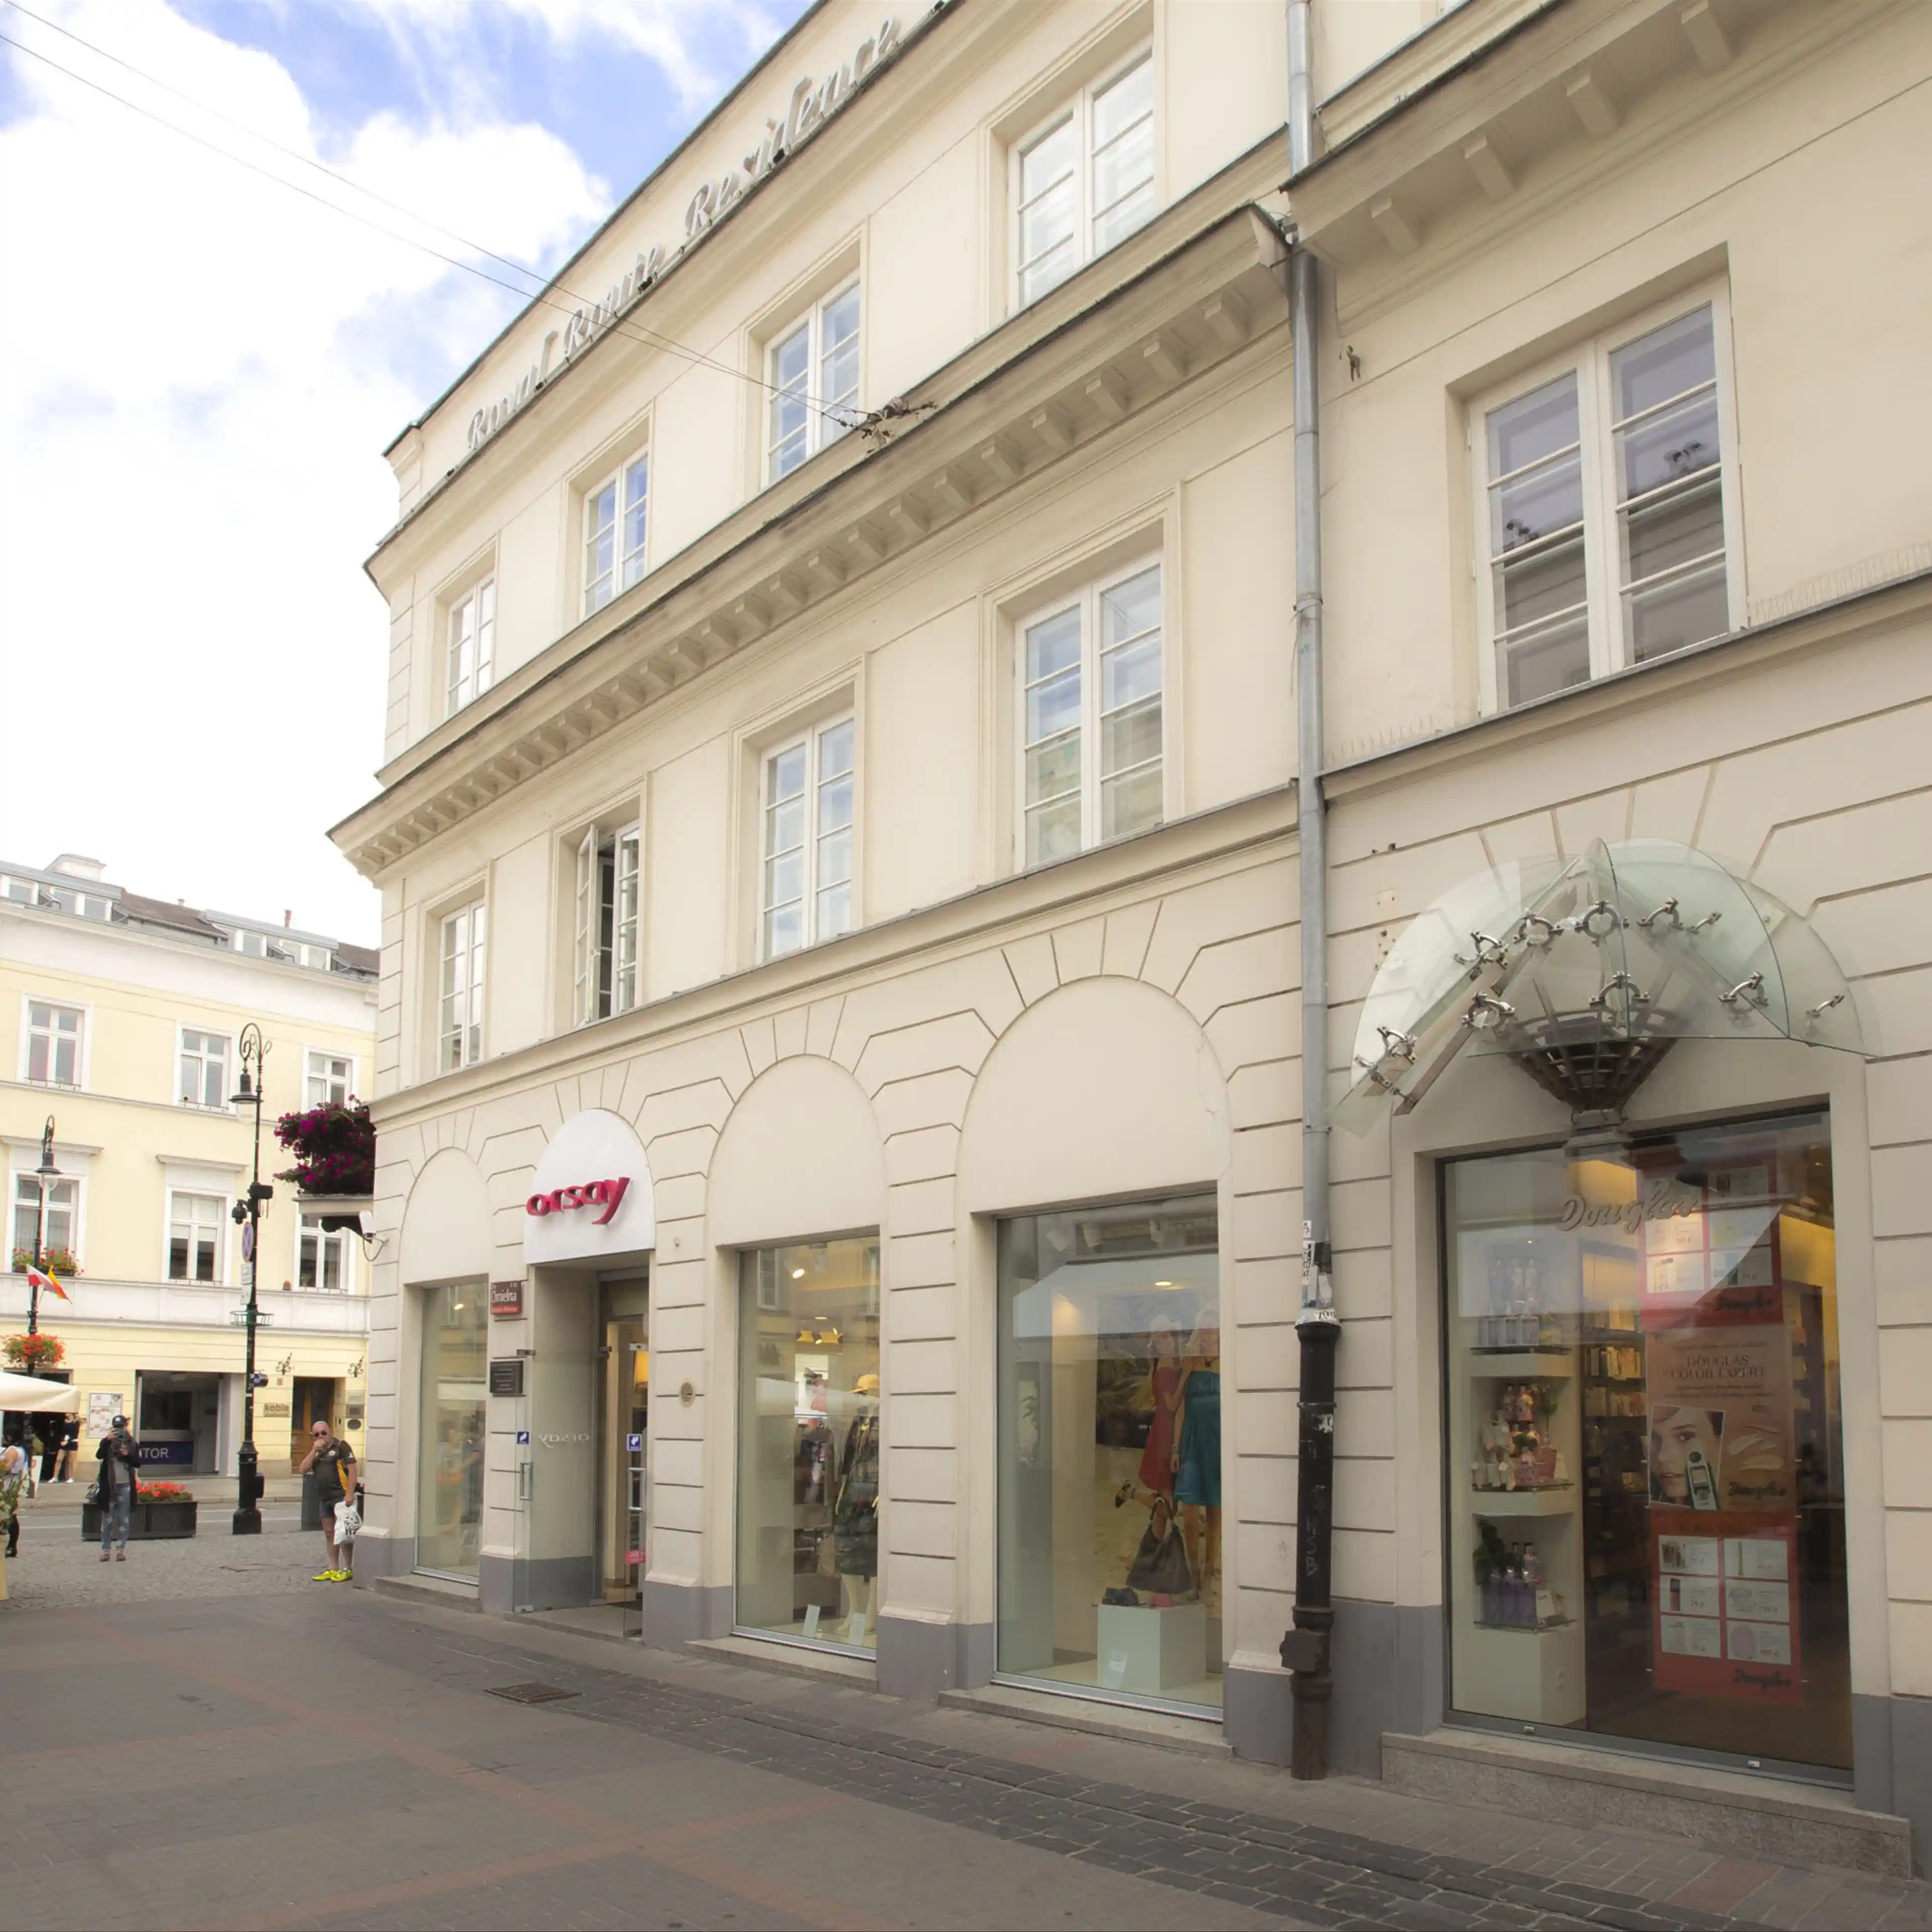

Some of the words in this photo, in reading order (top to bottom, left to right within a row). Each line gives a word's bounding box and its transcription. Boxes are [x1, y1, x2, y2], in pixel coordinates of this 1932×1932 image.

[526, 1177, 631, 1225] orsay
[1559, 1182, 1699, 1234] Douglas
[1670, 1368, 1714, 1380] COLOR
[1719, 1366, 1766, 1379] EXPERT
[1687, 1355, 1750, 1367] DOUGLAS
